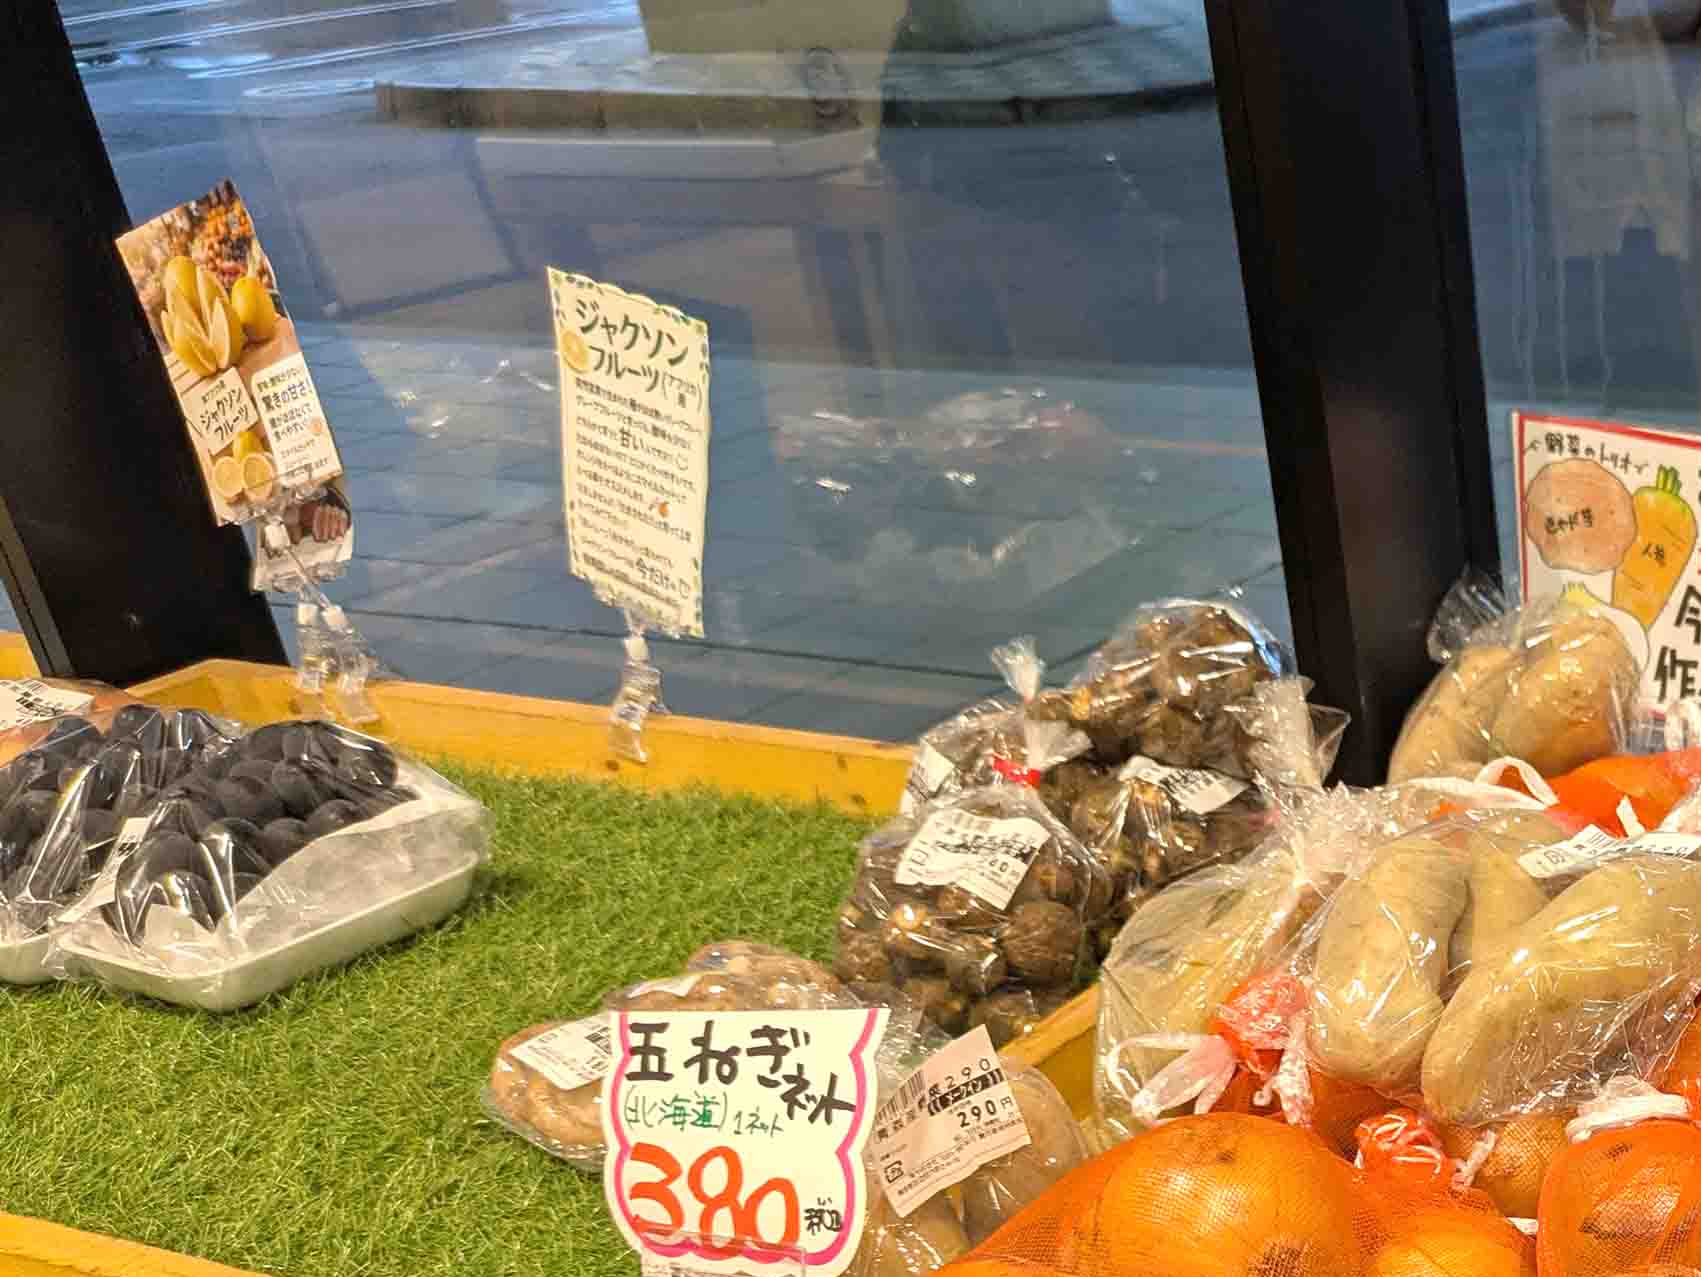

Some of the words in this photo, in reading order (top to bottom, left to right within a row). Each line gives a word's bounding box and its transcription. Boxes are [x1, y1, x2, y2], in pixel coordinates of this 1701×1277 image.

[576, 298, 689, 367] ジャクソン
[588, 345, 661, 393] フルーツ
[200, 388, 242, 430] ジャクソン
[214, 404, 250, 441] フルーツ
[624, 1085, 728, 1132] (北海道)
[627, 1141, 801, 1258] 380
